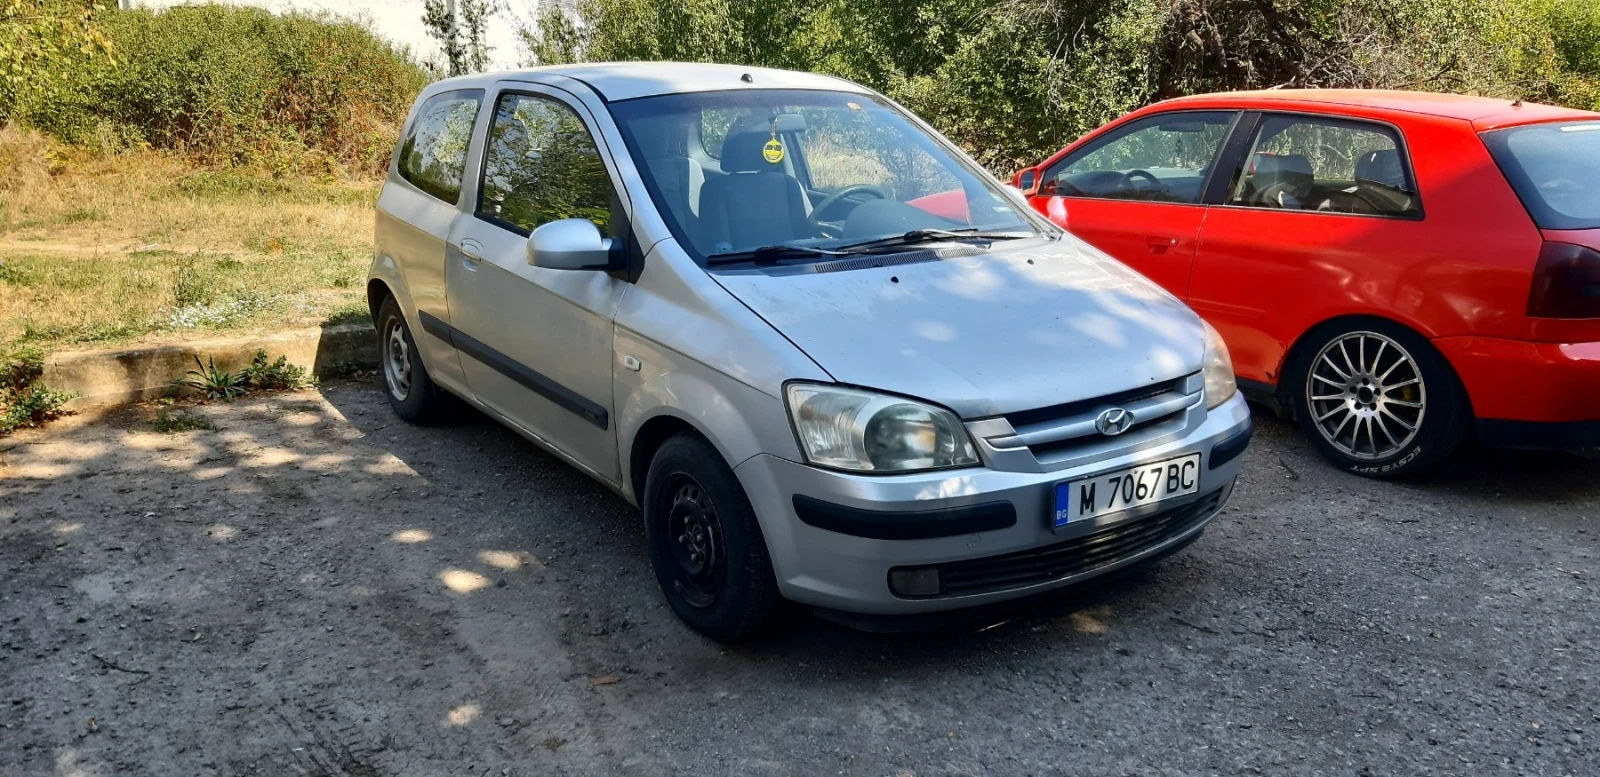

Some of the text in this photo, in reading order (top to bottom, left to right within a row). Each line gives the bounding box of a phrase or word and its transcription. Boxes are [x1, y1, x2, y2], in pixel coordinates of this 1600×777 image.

[1079, 460, 1195, 515] M 7067 BC
[1056, 509, 1067, 520] BG
